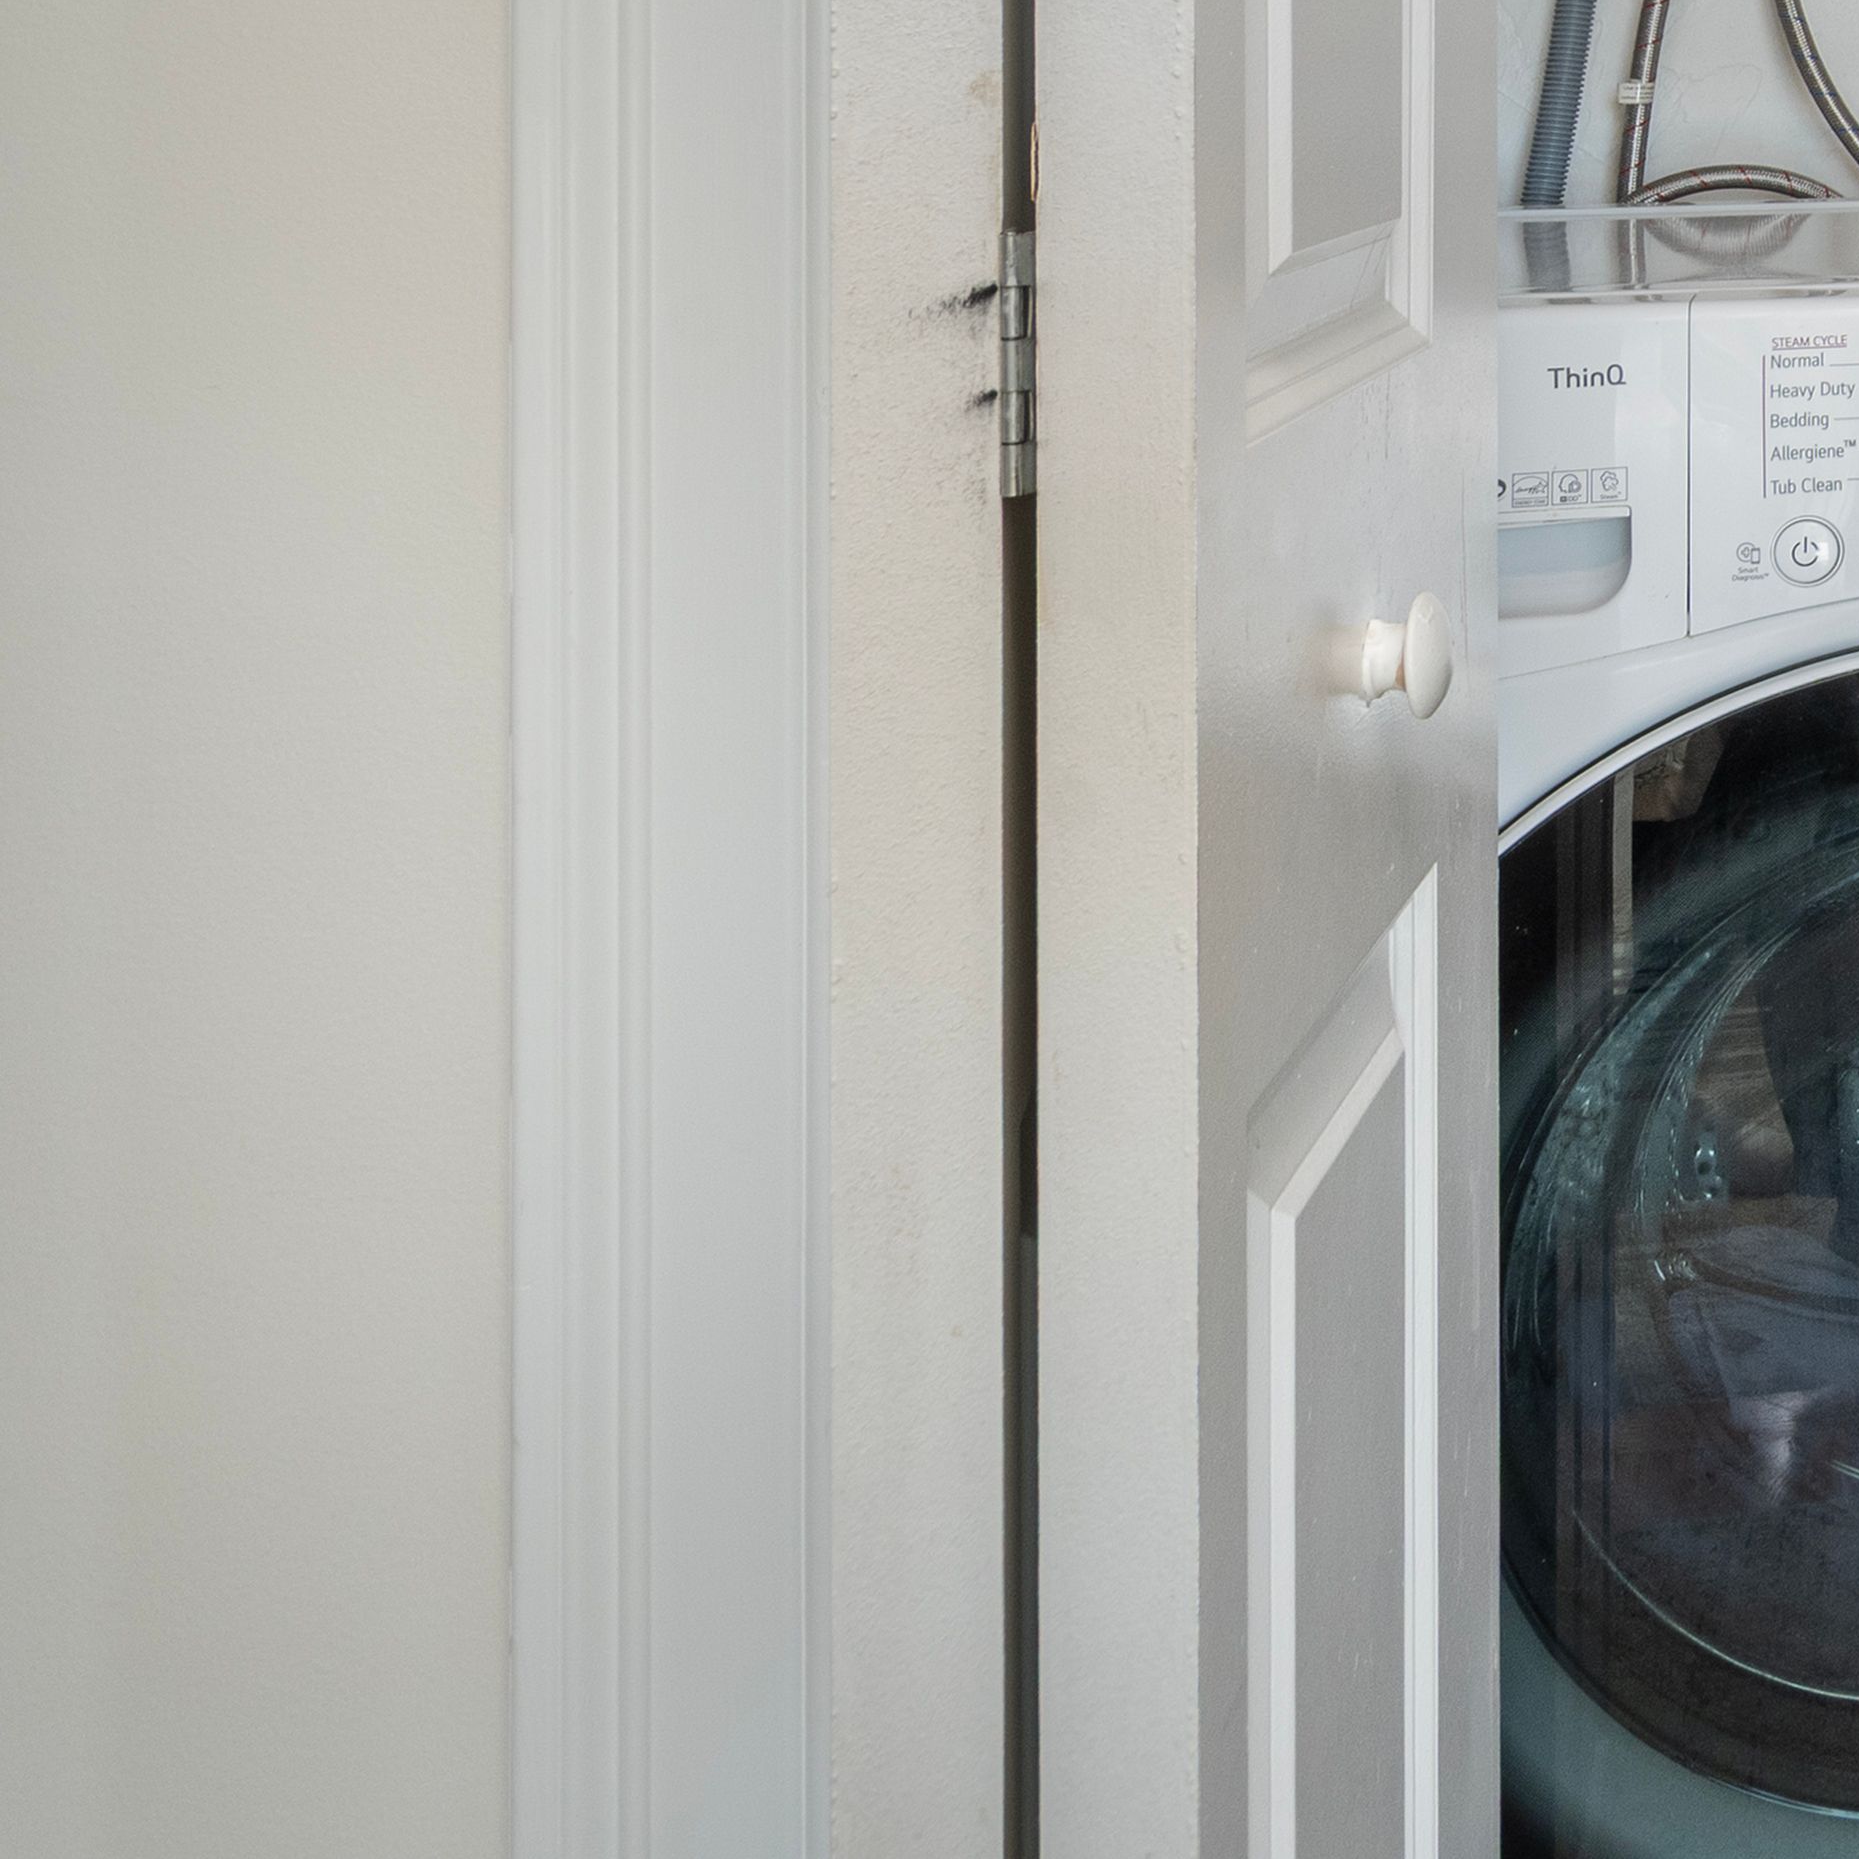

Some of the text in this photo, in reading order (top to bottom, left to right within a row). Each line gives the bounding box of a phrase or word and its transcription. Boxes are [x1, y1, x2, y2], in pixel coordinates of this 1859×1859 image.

[1772, 334, 1847, 348] STEAM CYCLE
[1770, 352, 1825, 370] Normal
[1547, 364, 1627, 390] ThinQ
[1770, 381, 1856, 402] Heavy Duty
[1770, 412, 1830, 430] Bedding
[1771, 477, 1844, 496] Tub Clean
